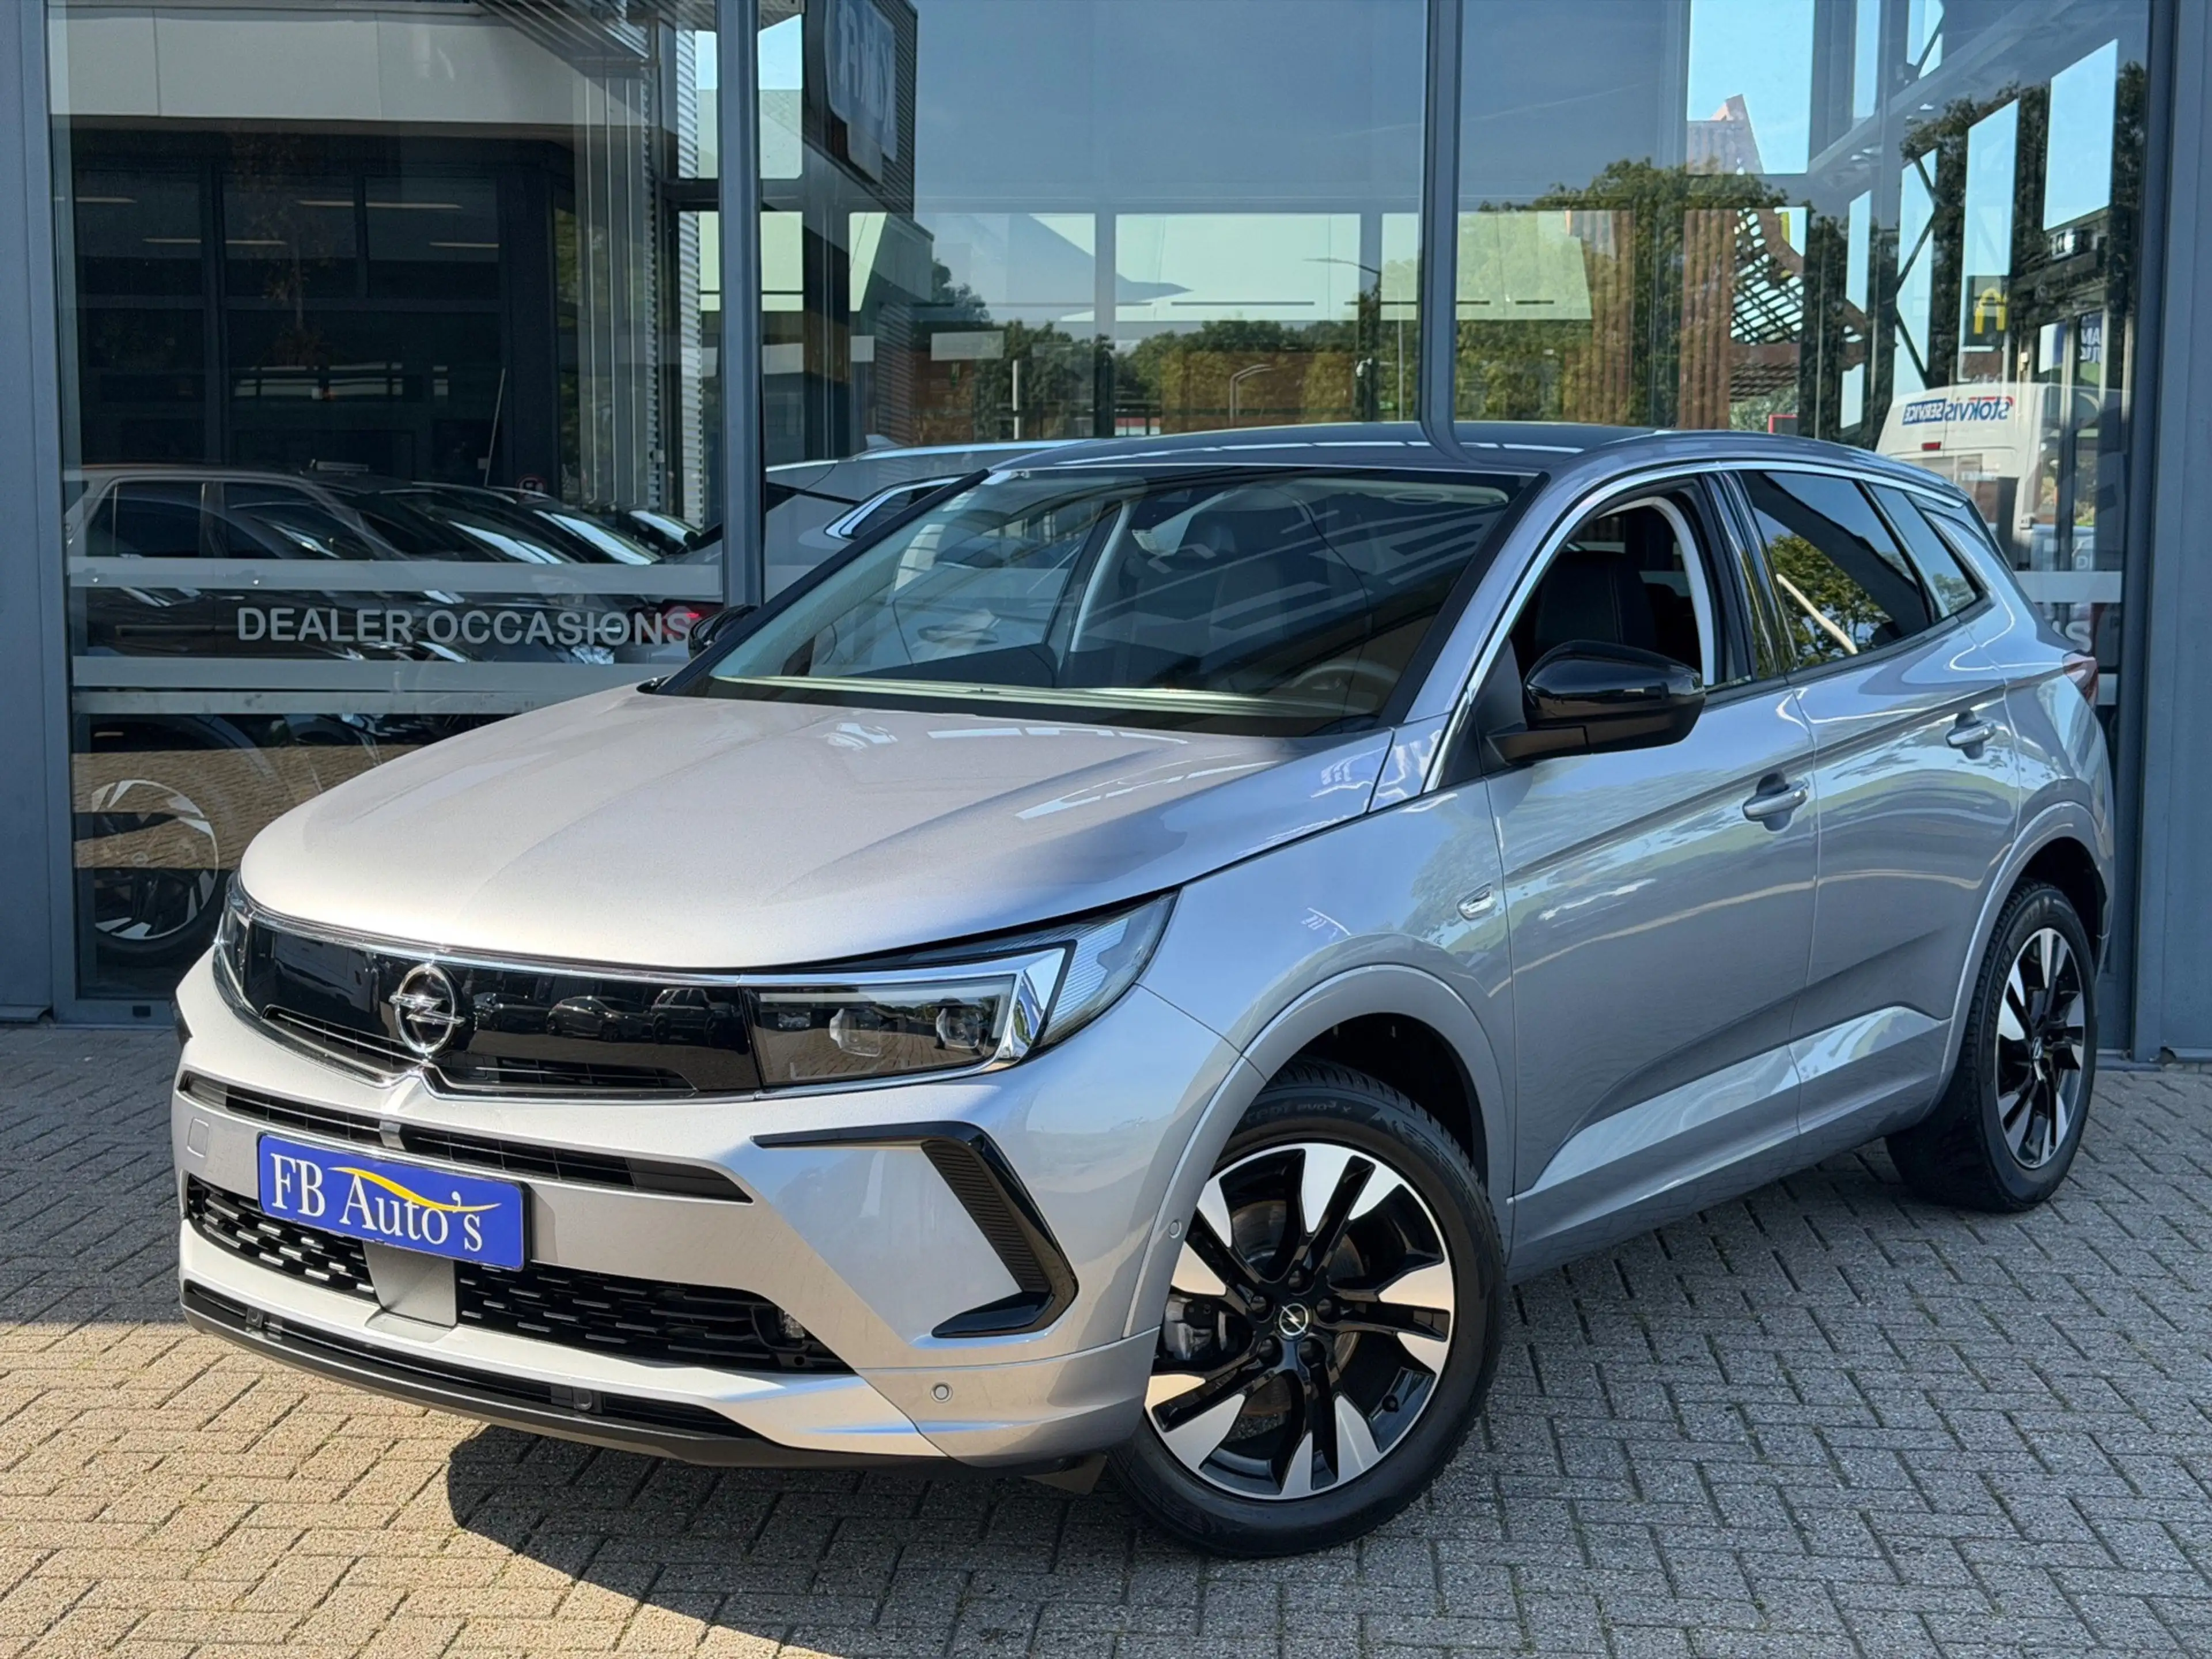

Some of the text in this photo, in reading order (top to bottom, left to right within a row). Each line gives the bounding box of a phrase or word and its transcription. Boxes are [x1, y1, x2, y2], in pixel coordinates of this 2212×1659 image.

[237, 607, 692, 646] DEALER OCCASIONS
[270, 1153, 483, 1252] FB Auto's
